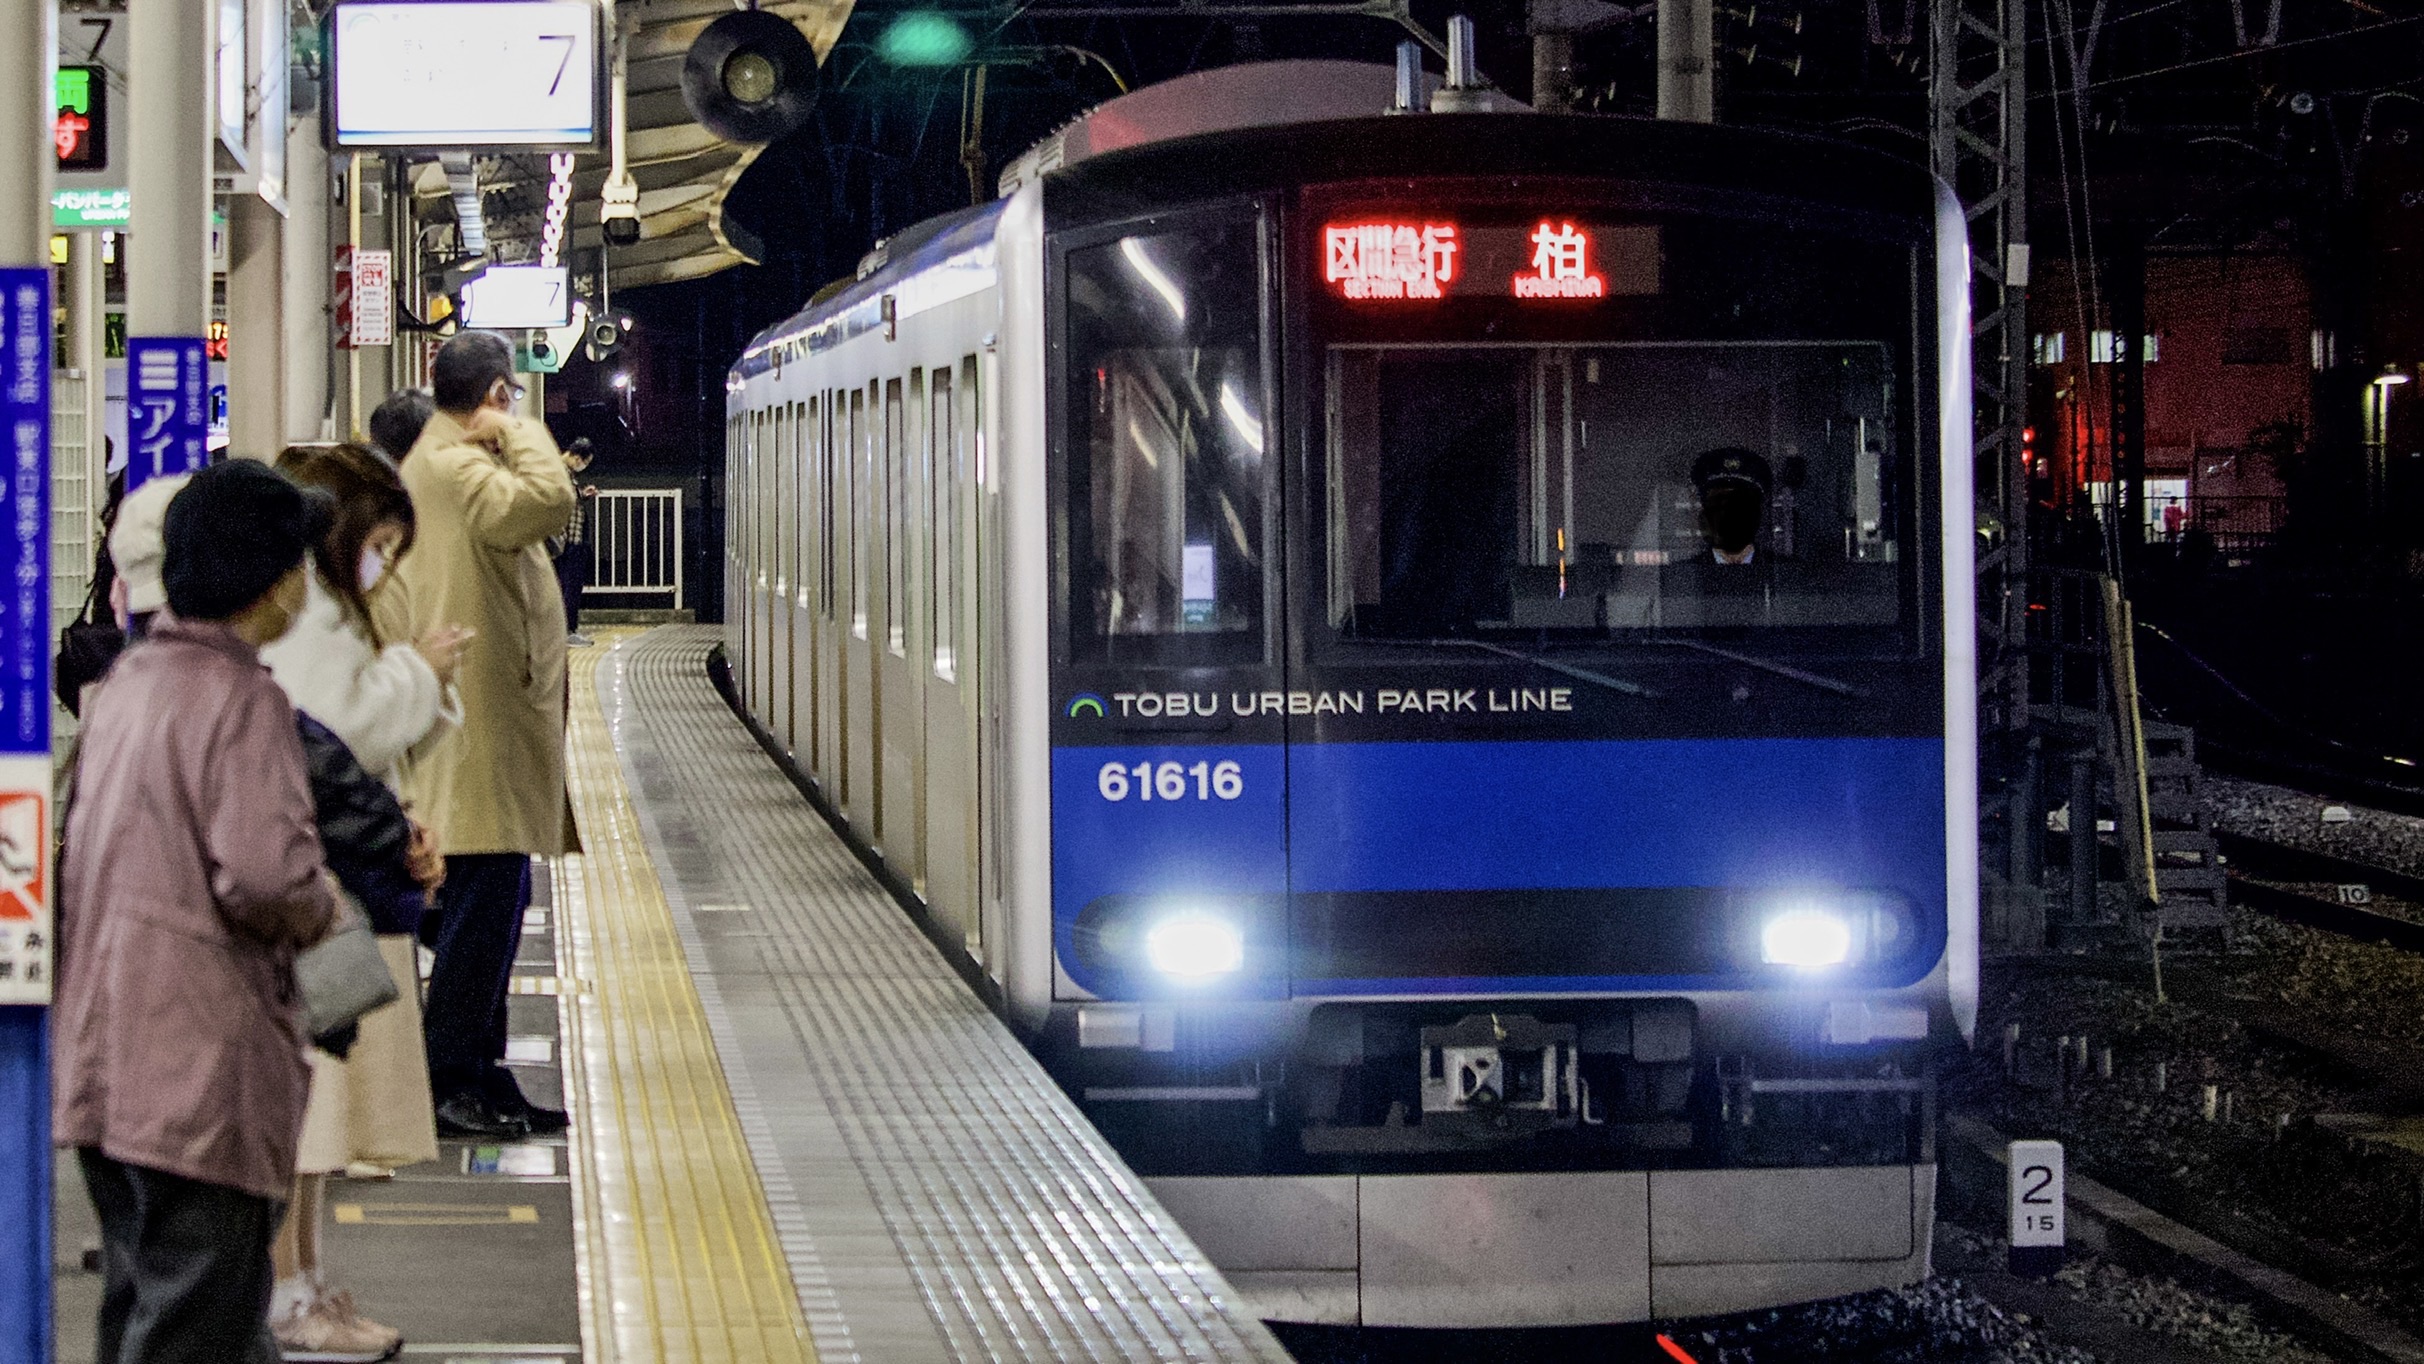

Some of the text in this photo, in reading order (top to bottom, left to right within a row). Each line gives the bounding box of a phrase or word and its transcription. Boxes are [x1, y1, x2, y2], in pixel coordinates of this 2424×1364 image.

[80, 18, 112, 61] 7
[539, 34, 576, 97] 7
[1326, 222, 1586, 283] 区間急行 柏
[544, 281, 560, 307] 7
[1514, 276, 1602, 298] KASHIWA
[1113, 687, 1574, 718] TOBU URBAN PARK LINE
[1098, 760, 1244, 801] 61616
[2342, 887, 2365, 902] 10
[2022, 1165, 2053, 1204] 2
[2026, 1215, 2054, 1231] 15
